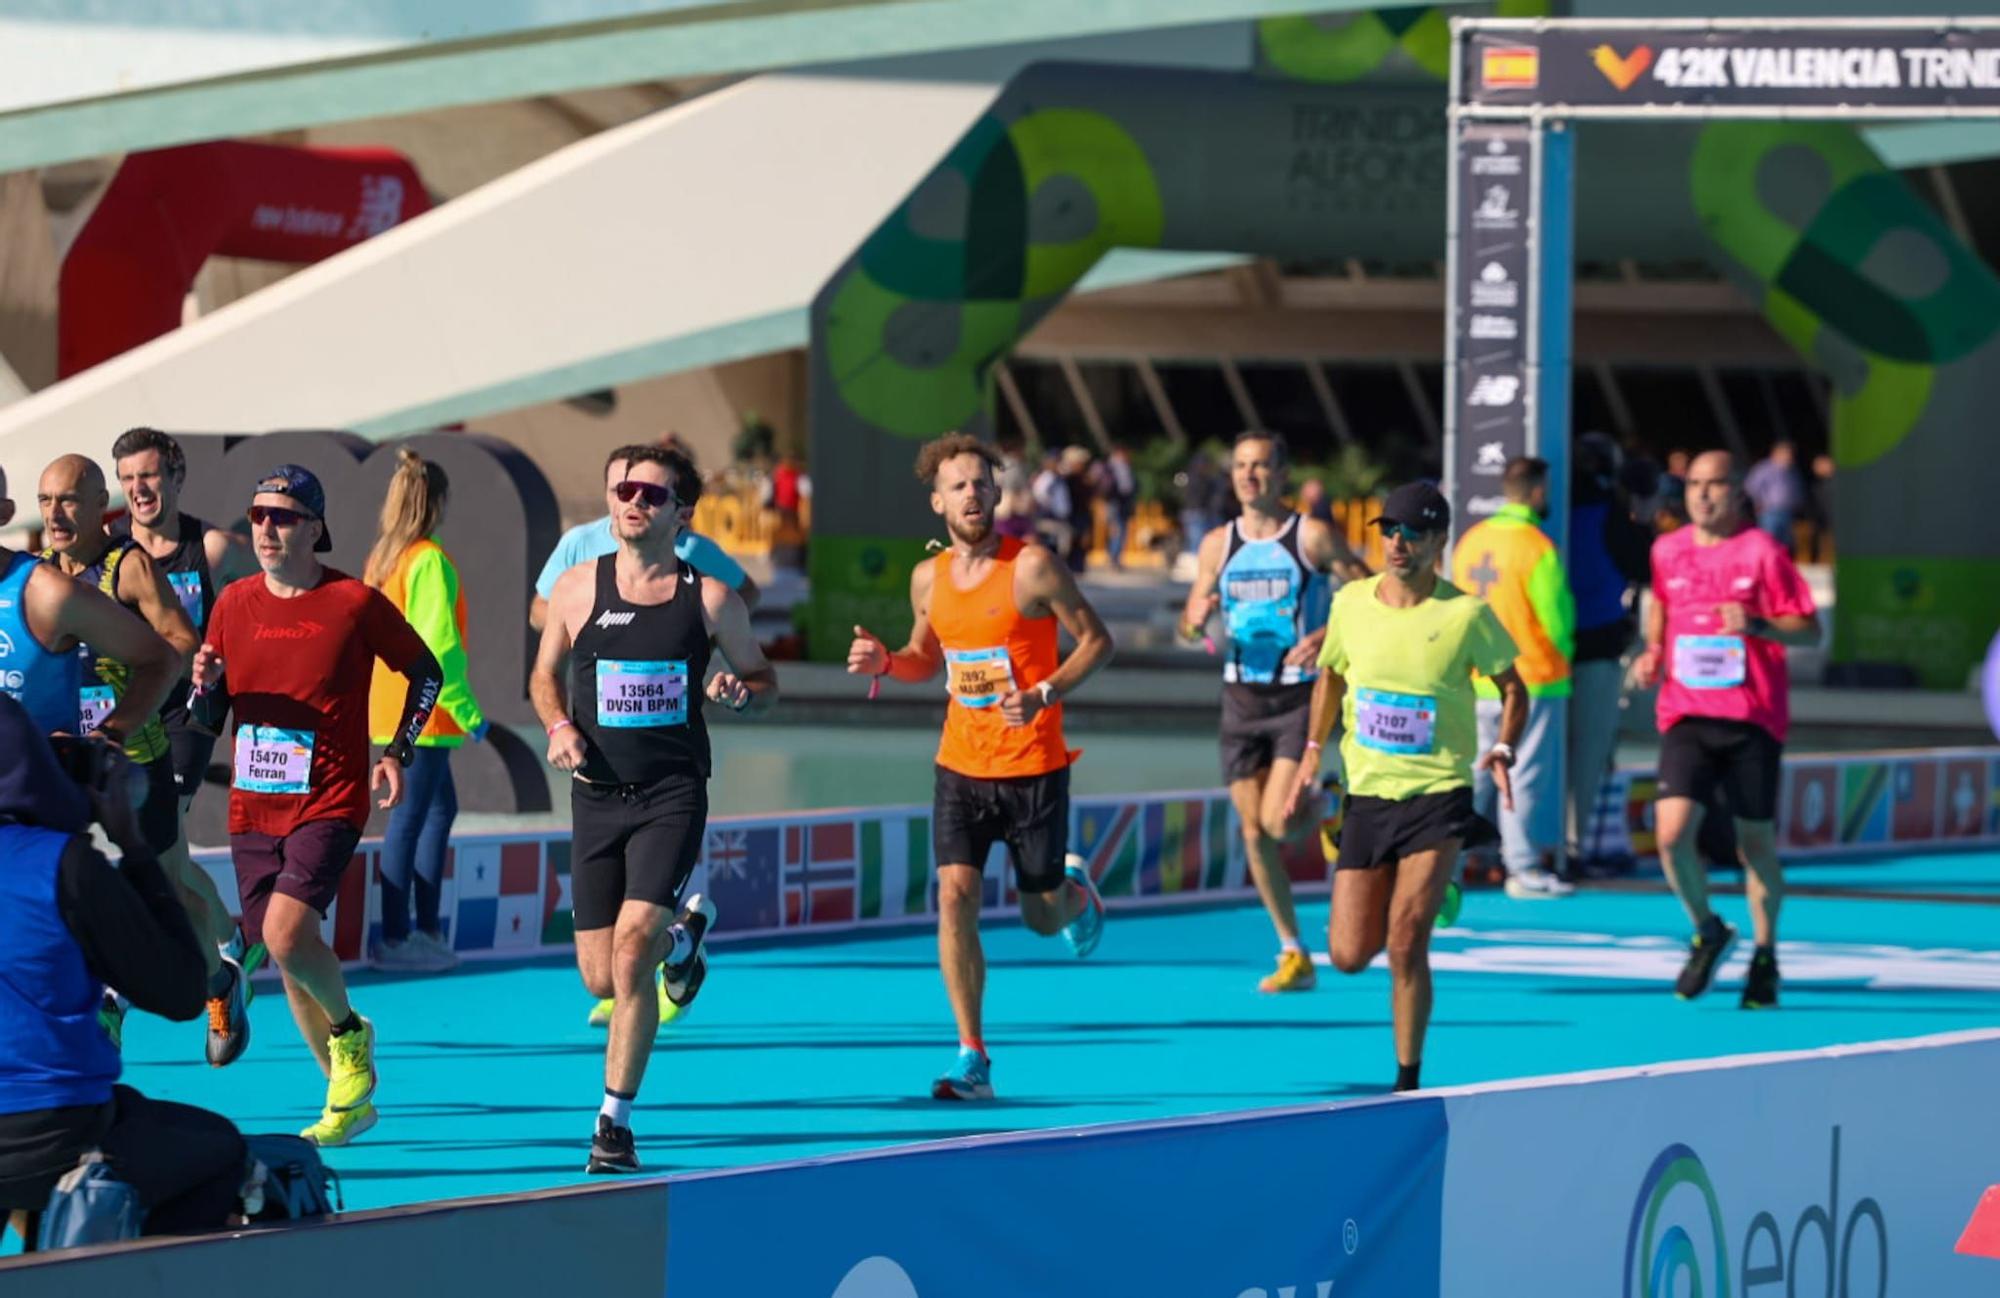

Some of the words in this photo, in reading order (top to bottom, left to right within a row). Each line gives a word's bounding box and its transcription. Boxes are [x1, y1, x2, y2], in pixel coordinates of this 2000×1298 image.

[1653, 48, 1730, 88] 42K
[1731, 48, 1900, 88] VALENCIA
[619, 683, 664, 698] 13564
[606, 699, 642, 713] DVSN
[648, 697, 679, 713] BPM
[250, 749, 288, 766] 15470
[248, 764, 287, 781] Ferran
